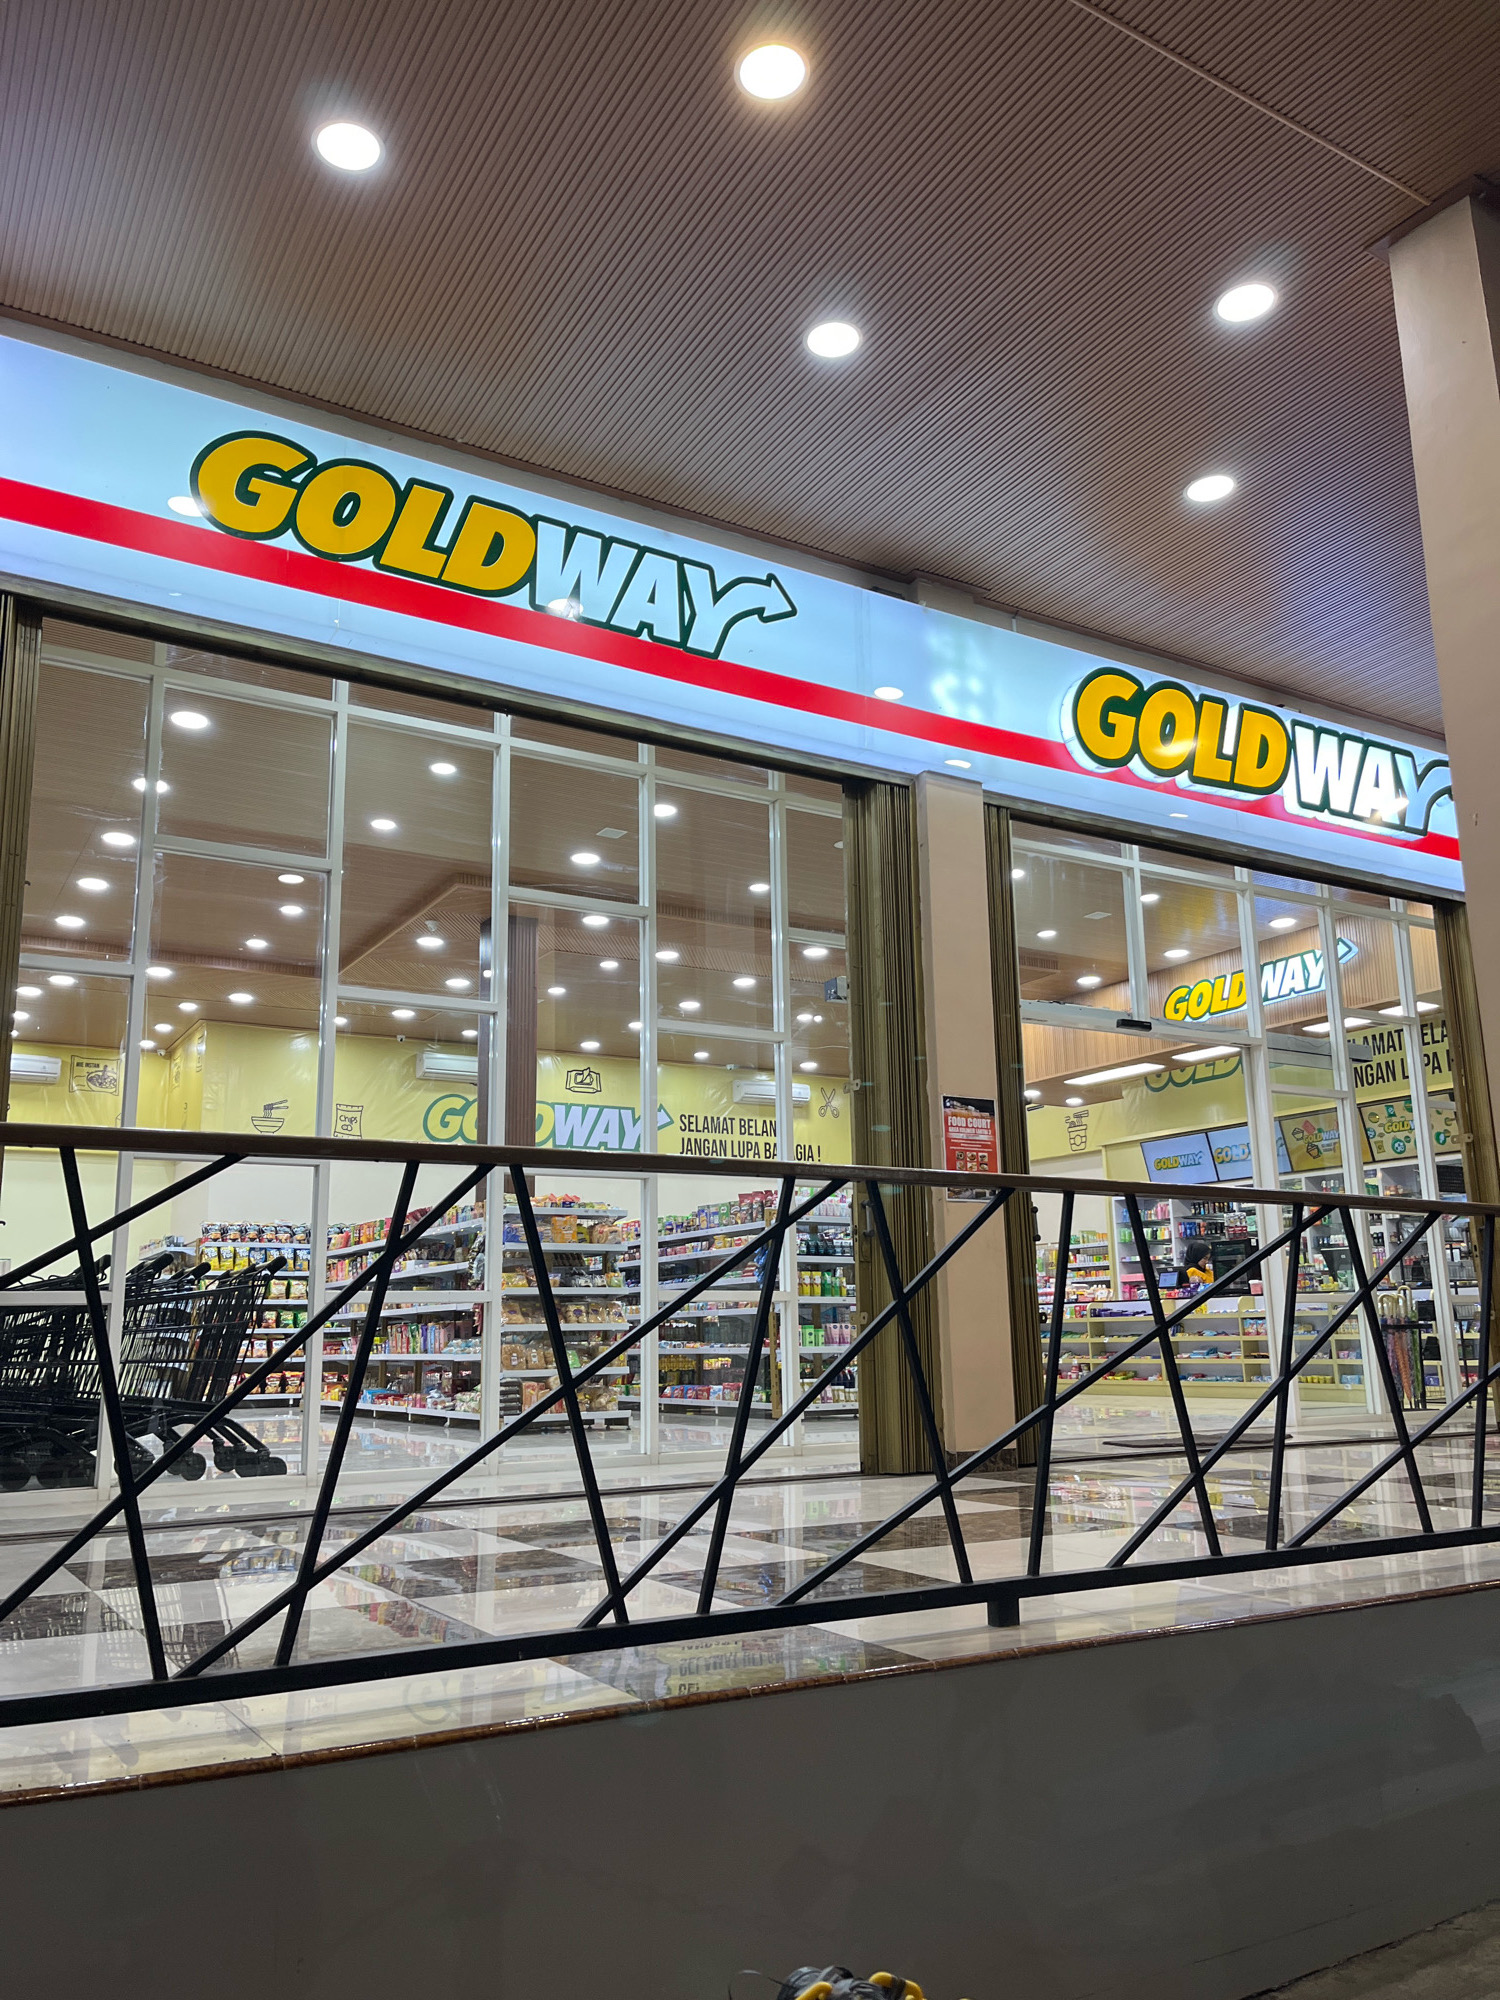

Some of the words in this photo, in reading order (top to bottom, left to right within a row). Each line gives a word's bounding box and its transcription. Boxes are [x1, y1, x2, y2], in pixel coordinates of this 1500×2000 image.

[189, 430, 798, 659] GOLDWAY
[1072, 666, 1453, 836] GOLDWAY
[1353, 1059, 1397, 1089] NGAN
[1400, 1050, 1443, 1081] LPA
[679, 1113, 735, 1135] SELAMAT
[739, 1118, 778, 1138] BELAN
[948, 1116, 966, 1127] FOOD
[967, 1118, 991, 1129] COURT
[1383, 1119, 1415, 1134] GOLD
[679, 1137, 727, 1158] JANGAN
[731, 1140, 761, 1160] LUPA
[764, 1142, 815, 1162] BAGIA
[1153, 1150, 1204, 1171] GOLDWAY
